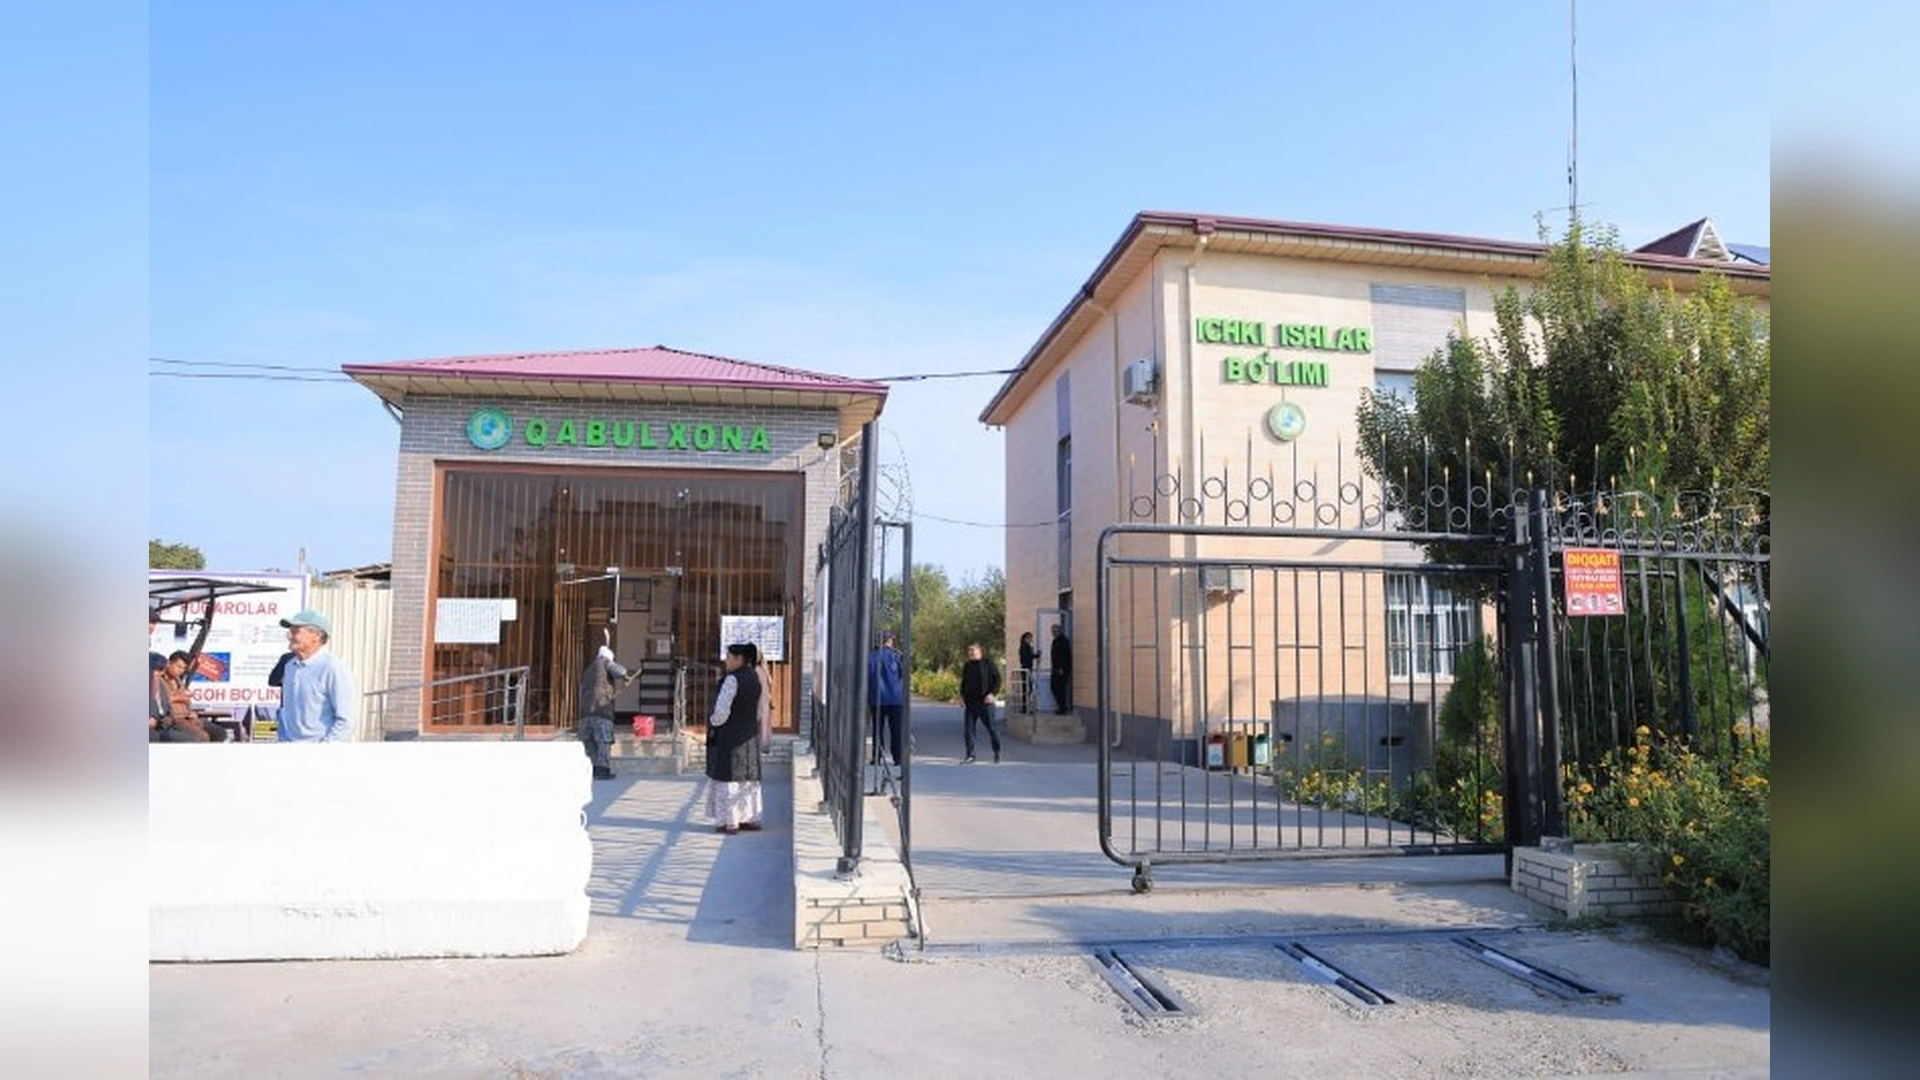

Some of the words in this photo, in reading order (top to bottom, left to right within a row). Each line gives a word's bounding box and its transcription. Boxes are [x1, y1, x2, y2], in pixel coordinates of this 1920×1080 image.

[1196, 317, 1265, 346] ICHKI
[1278, 323, 1372, 353] ISHLAR
[524, 417, 771, 452] QABULXONA
[192, 688, 225, 701] GOH
